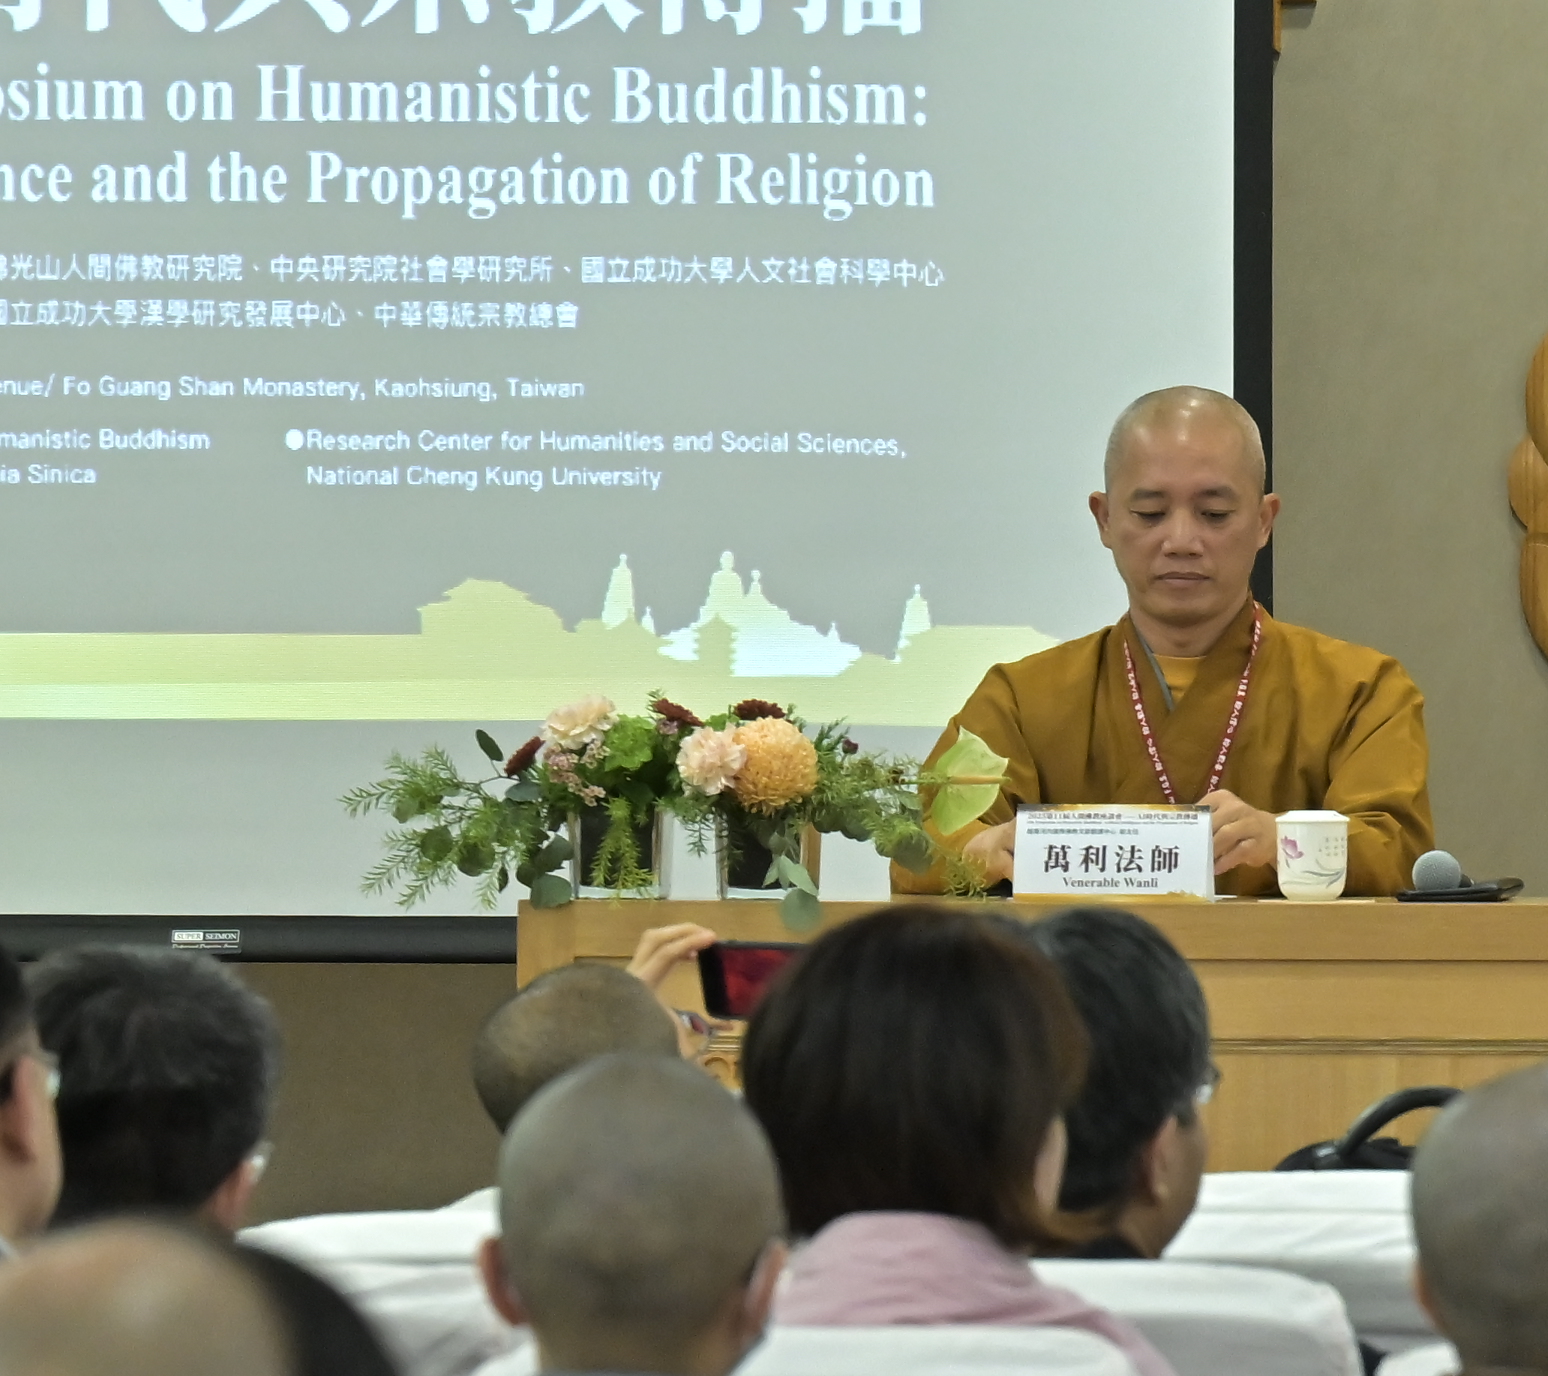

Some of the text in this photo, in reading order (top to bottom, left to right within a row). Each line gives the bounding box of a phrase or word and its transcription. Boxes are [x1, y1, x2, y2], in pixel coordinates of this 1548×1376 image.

[0, 62, 927, 127] sium on Humanistic Buddhism:
[91, 150, 188, 204] and
[208, 151, 288, 204] the
[307, 151, 630, 220] Propagation
[649, 152, 705, 206] of
[716, 153, 935, 222] Religion
[63, 375, 91, 396] Fo
[98, 374, 172, 401] Guang
[178, 375, 235, 397] Shan
[243, 377, 366, 402] Monastery,
[374, 377, 498, 403] Kaohsiung,
[507, 377, 585, 398] Taiwan
[98, 428, 211, 450] Buddhism
[306, 428, 907, 459] Research Center for Humanities and Social Sciences,
[27, 463, 97, 484] Sinica
[306, 465, 662, 493] National Cheng Kung University
[1044, 844, 1180, 874] 萬利法師
[1062, 876, 1158, 888] Venerable Wanli
